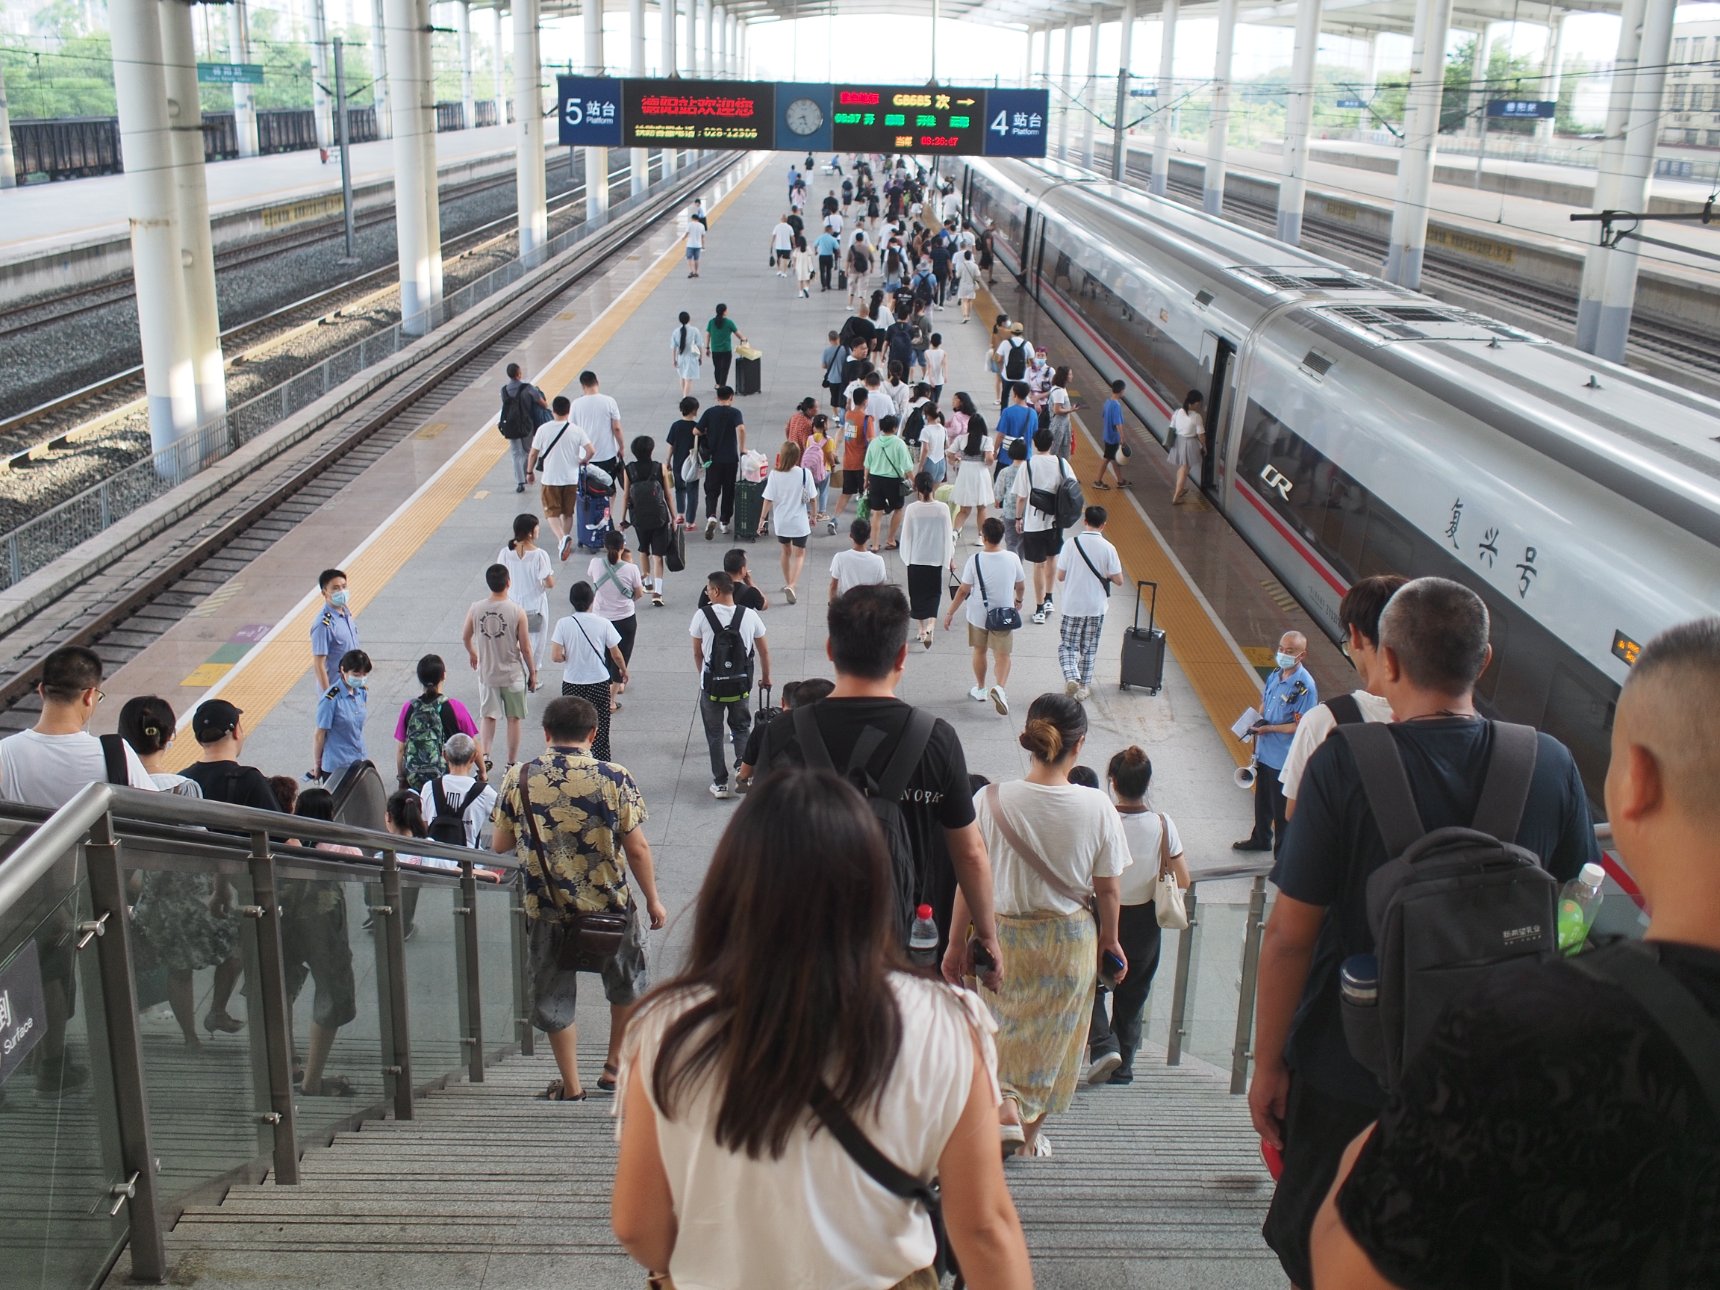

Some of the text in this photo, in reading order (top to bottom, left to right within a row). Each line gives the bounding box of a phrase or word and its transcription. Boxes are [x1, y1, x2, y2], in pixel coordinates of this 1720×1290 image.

[565, 97, 615, 125] 5 站台
[936, 93, 951, 110] 次
[586, 116, 613, 124] Platform
[990, 110, 1042, 136] 4 站台
[1012, 127, 1040, 136] Platform
[1260, 463, 1293, 501] CR
[1445, 497, 1537, 599] 复兴号
[3, 1017, 33, 1055] Surface
